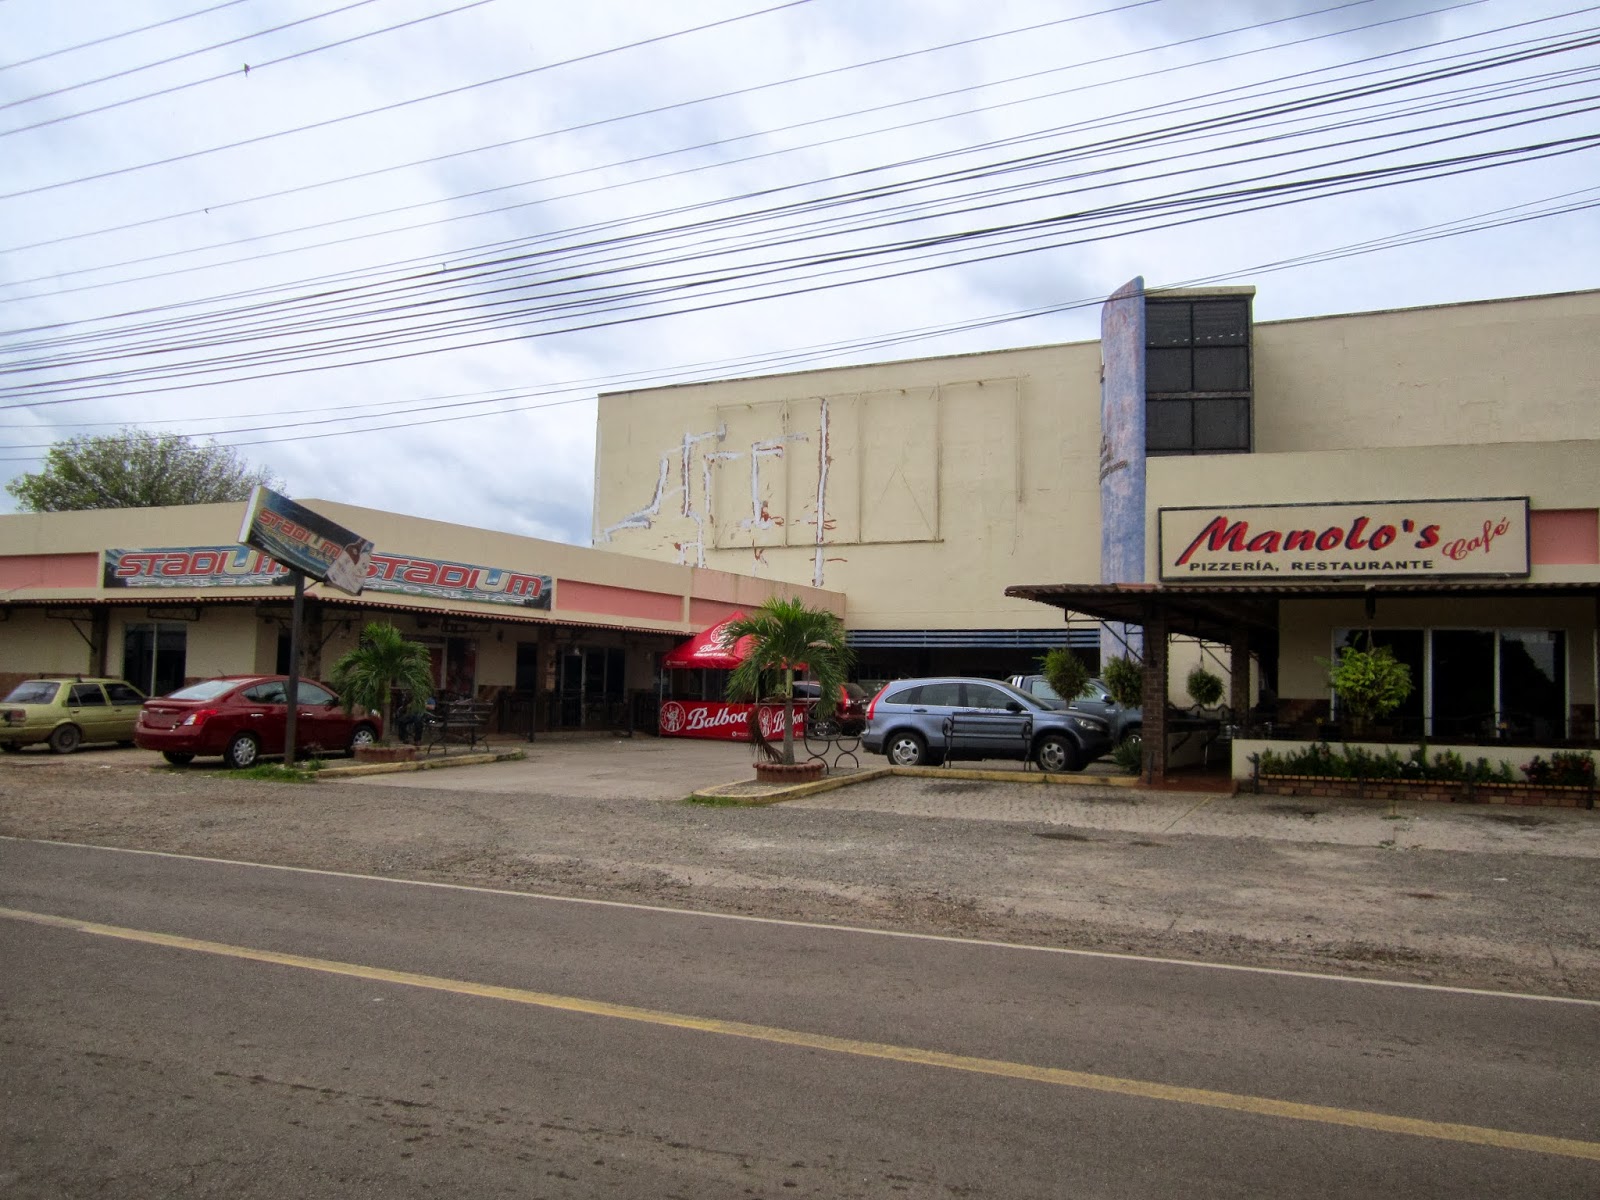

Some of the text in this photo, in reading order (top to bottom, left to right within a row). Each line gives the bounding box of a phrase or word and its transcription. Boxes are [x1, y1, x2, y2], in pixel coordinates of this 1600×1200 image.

[1175, 514, 1511, 566] Manolo's Café
[1189, 558, 1434, 572] PIZZERÍA, RESTAURANTE
[686, 707, 748, 730] Balboa
